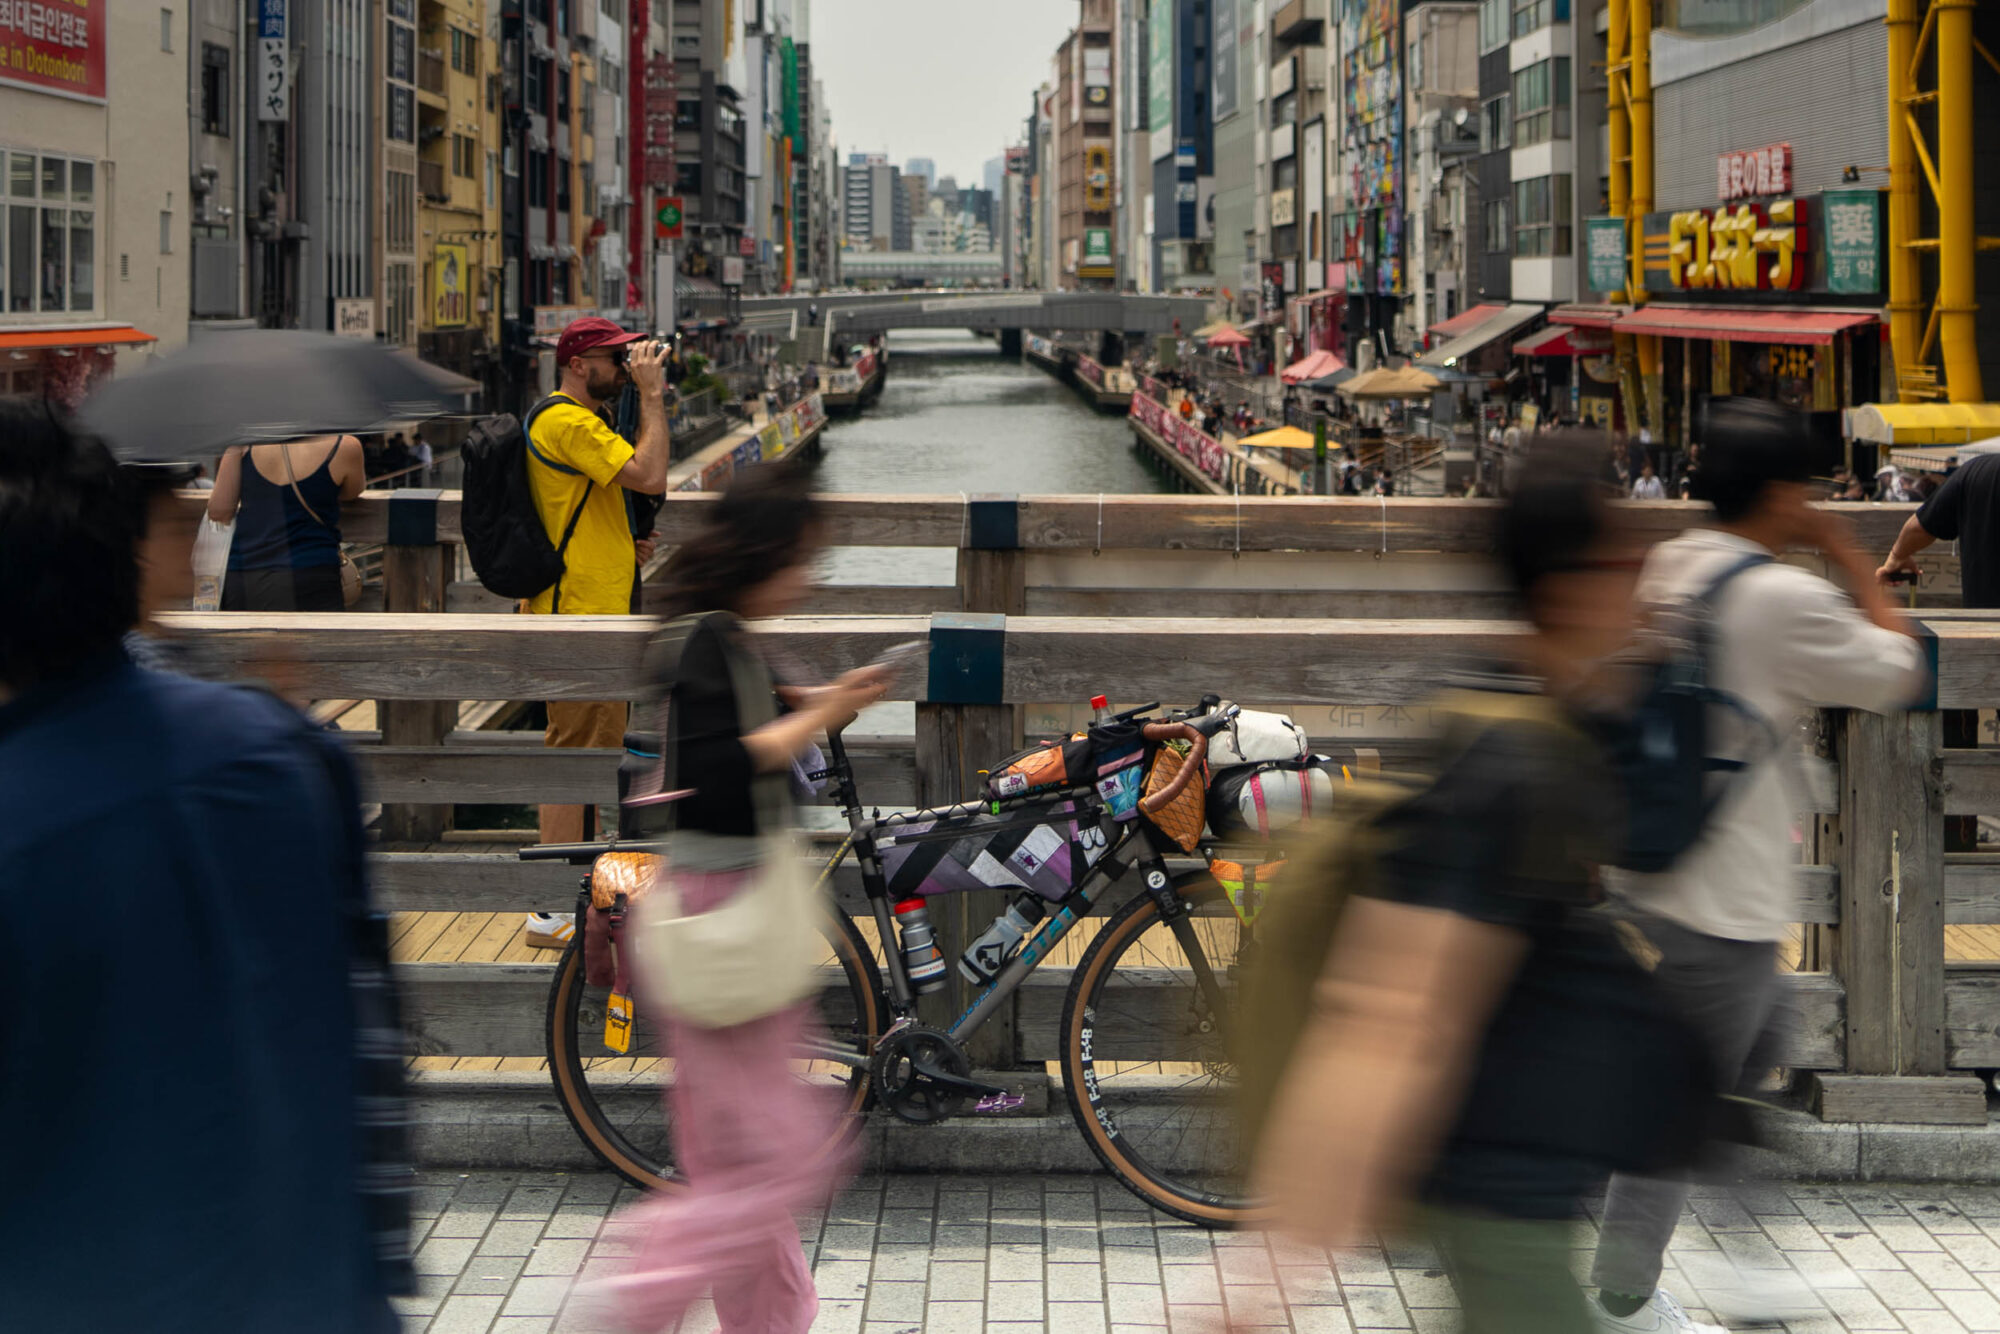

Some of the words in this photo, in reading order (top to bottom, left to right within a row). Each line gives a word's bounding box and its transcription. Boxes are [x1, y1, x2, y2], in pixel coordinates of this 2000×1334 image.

[11, 41, 23, 69] in
[26, 45, 87, 84] Dotonbori
[1830, 203, 1873, 246] 薬
